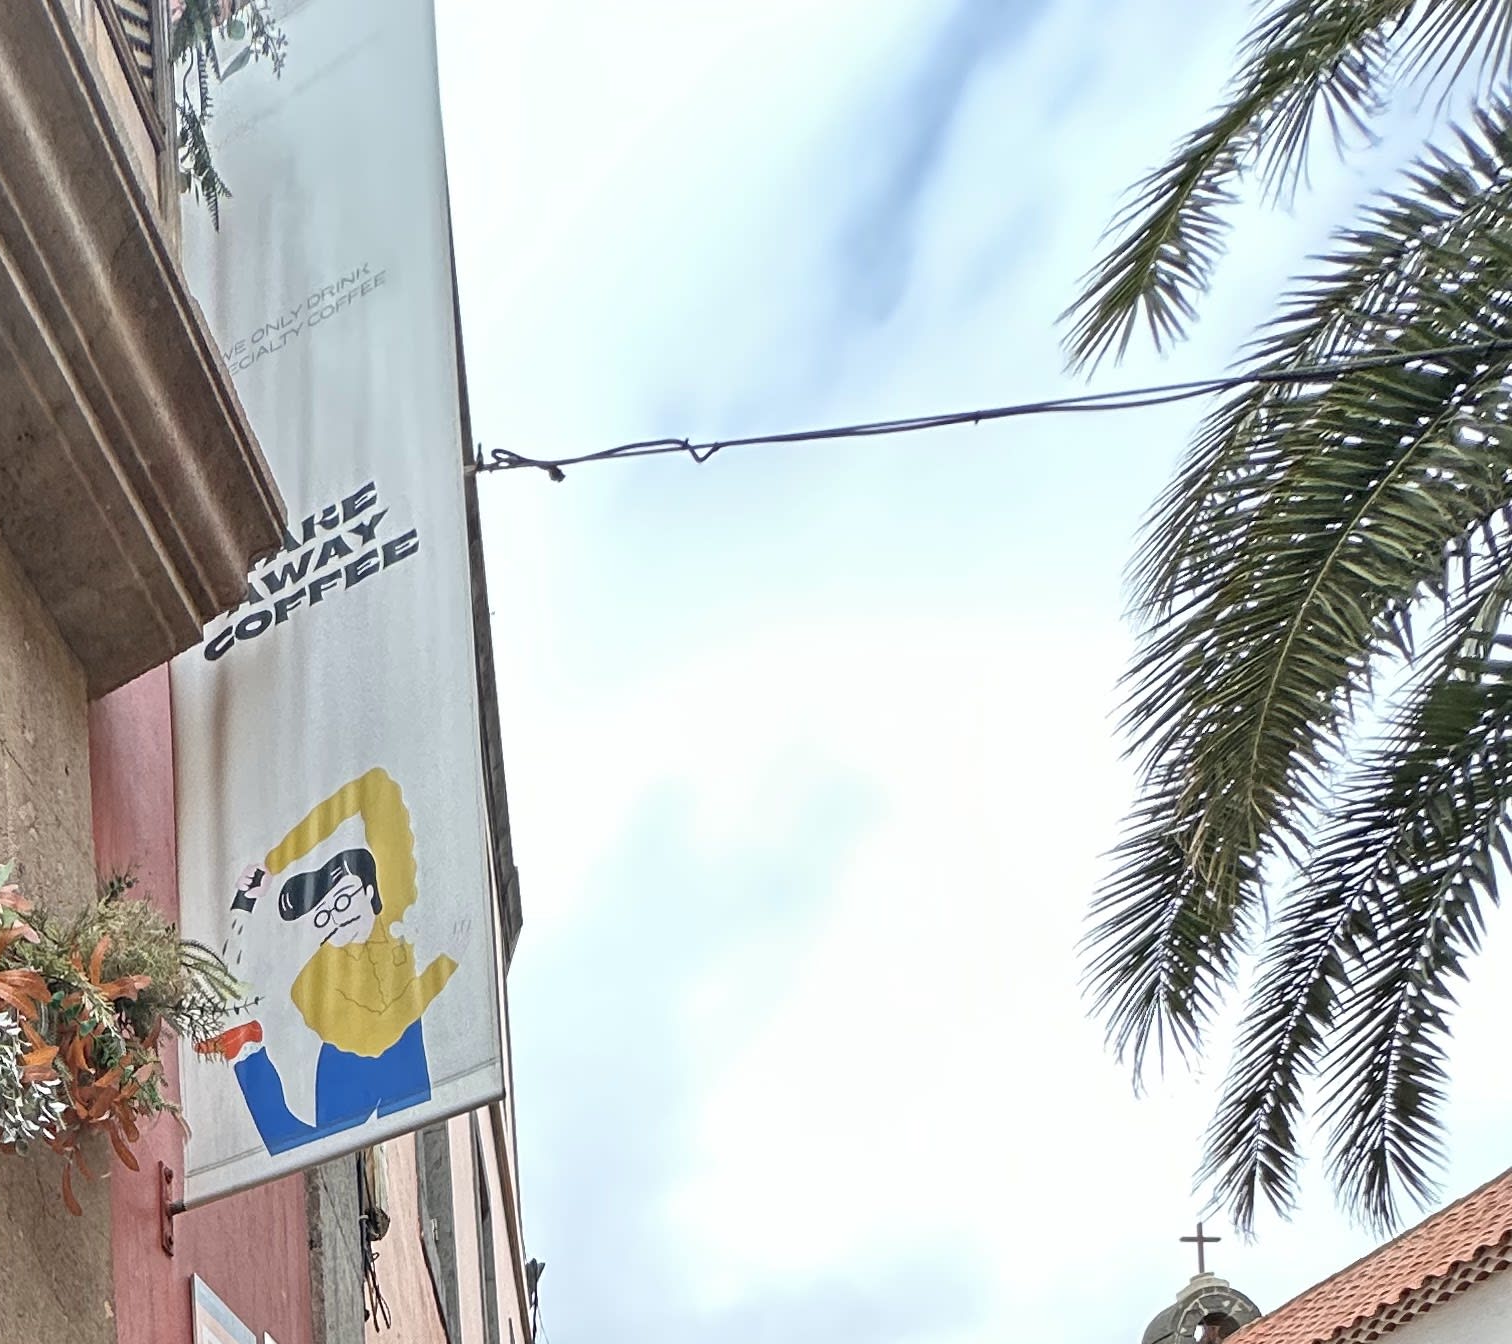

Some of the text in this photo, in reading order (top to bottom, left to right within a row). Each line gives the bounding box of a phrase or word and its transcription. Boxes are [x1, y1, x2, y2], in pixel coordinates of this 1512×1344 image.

[228, 270, 387, 376] ECIALTY COFFEE
[251, 304, 303, 344] ONLY
[307, 262, 371, 310] DRINK
[264, 481, 377, 566] KE
[203, 528, 420, 662] COFFEE
